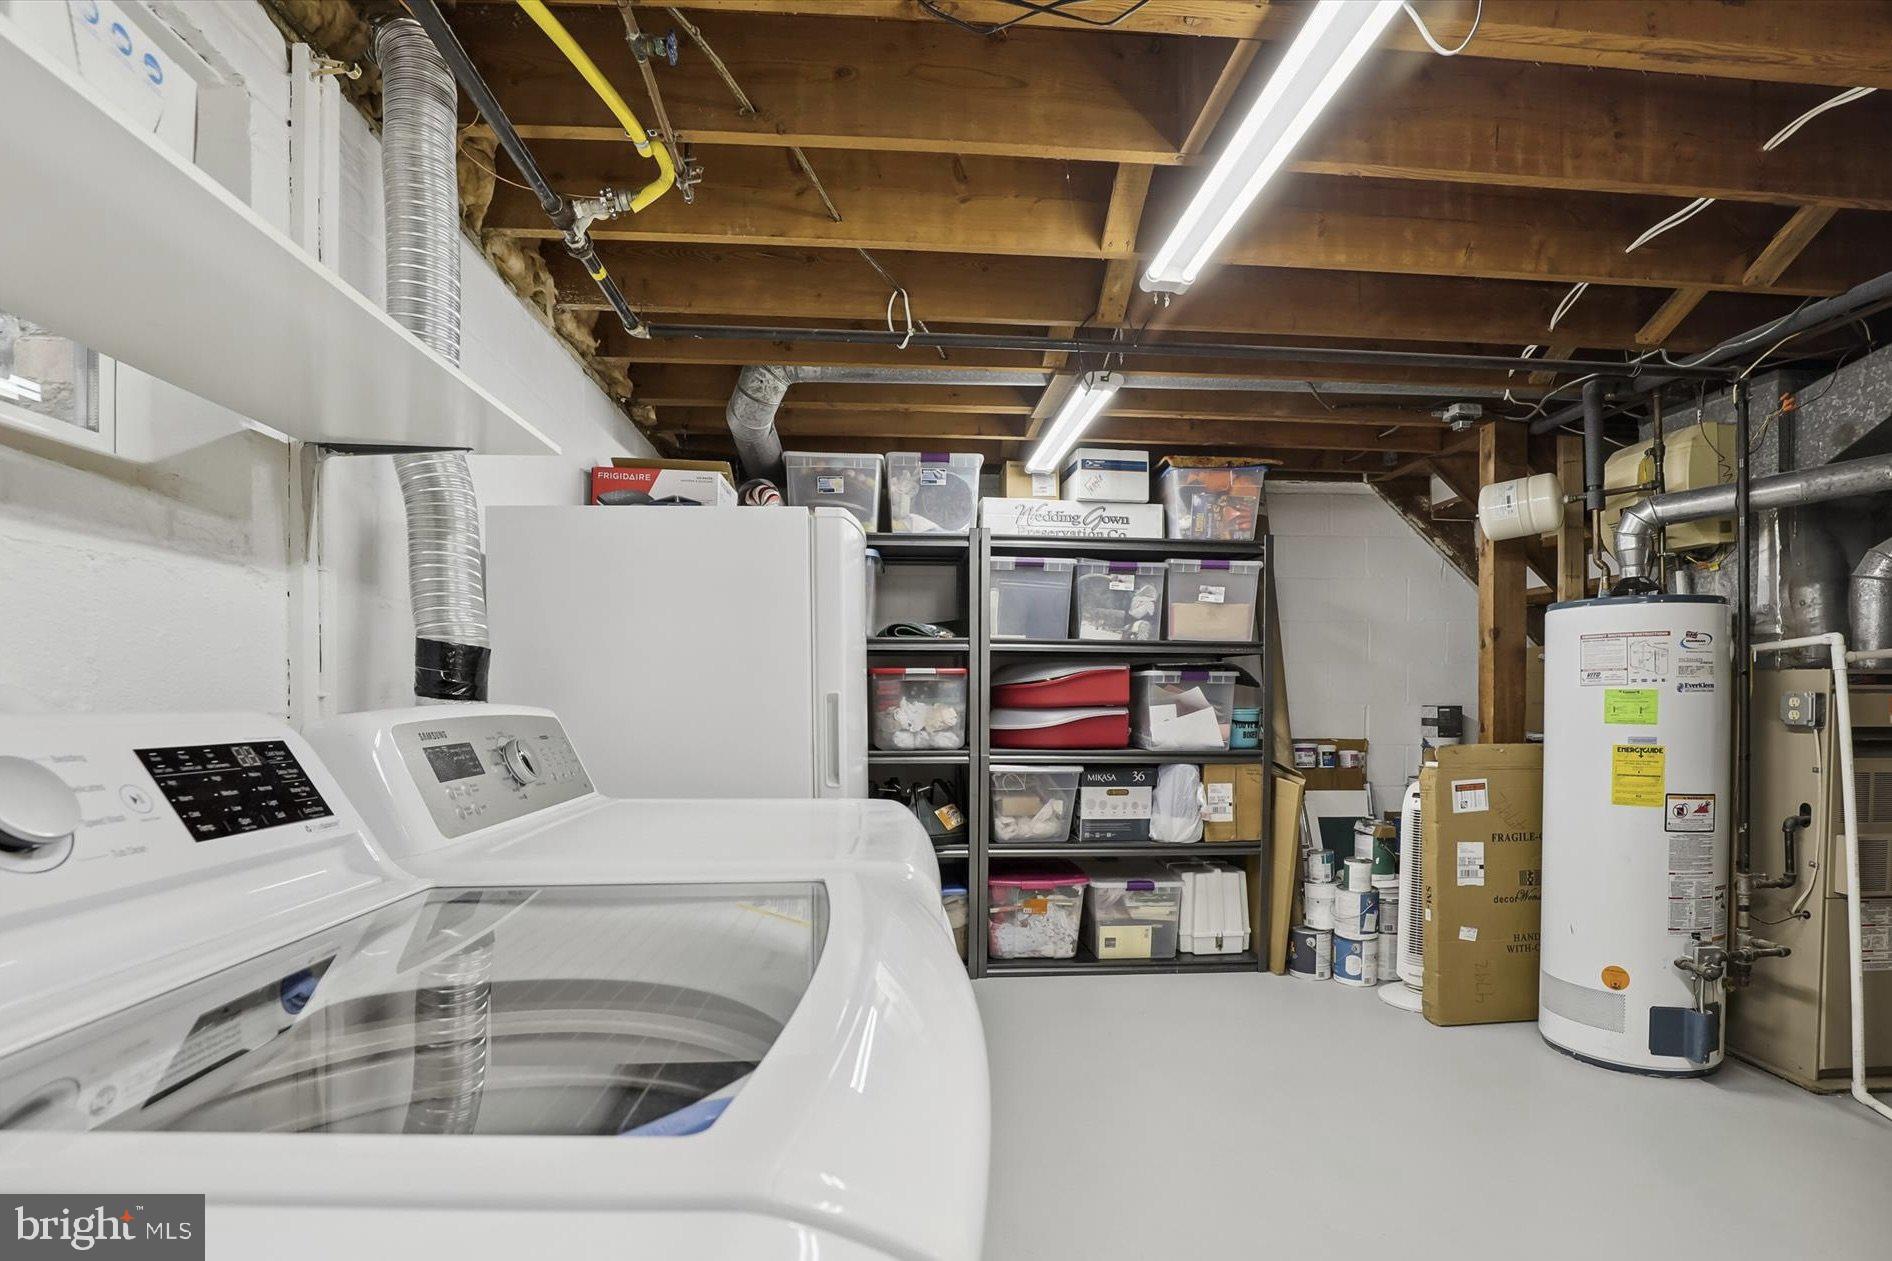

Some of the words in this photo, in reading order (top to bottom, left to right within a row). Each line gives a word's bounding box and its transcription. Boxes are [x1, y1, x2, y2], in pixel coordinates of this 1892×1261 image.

[597, 471, 651, 481] FRIGIDAIRE
[1015, 503, 1081, 526] Wedding
[1082, 506, 1130, 530] Gown
[418, 730, 448, 742] SAMSUNG
[1087, 773, 1117, 783] MIKASA
[1131, 770, 1146, 782] 36
